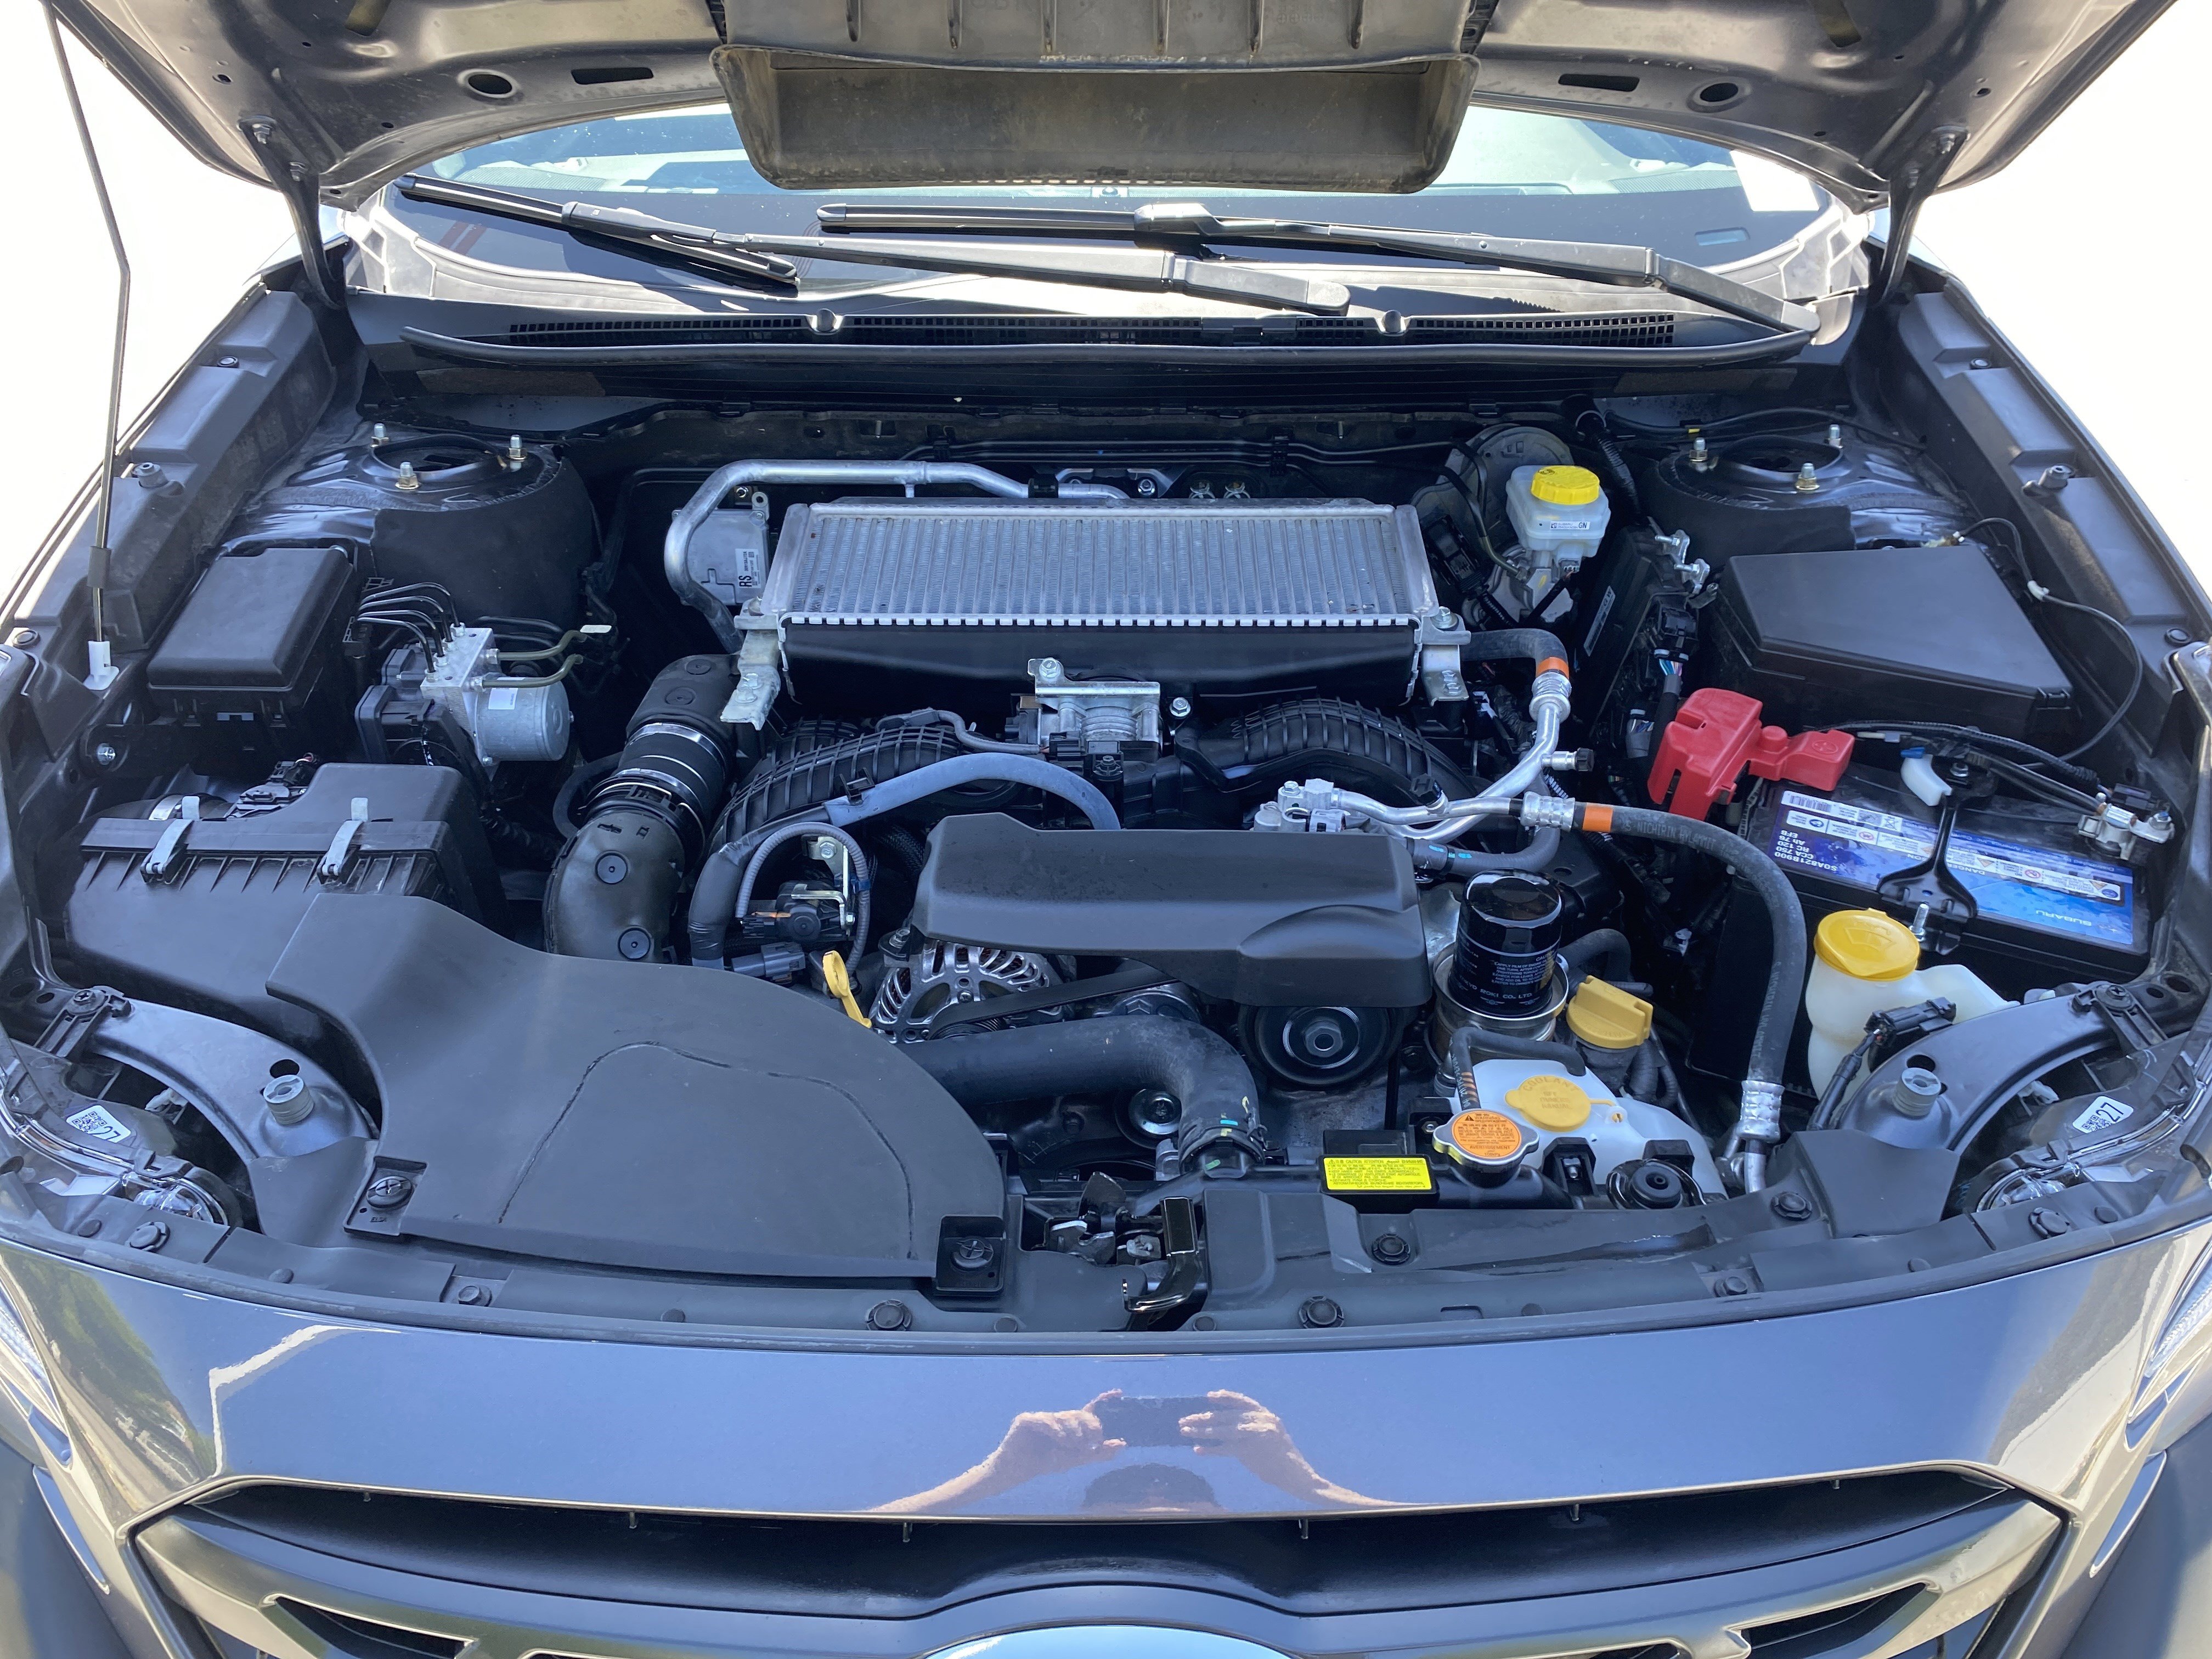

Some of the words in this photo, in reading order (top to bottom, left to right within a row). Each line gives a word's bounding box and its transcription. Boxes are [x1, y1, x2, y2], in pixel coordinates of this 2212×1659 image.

[738, 575, 752, 587] RS
[1781, 830, 1798, 838] EFB
[1778, 840, 1794, 849] 120
[1776, 845, 1793, 855] 750
[1795, 850, 1814, 859] CCA
[2036, 910, 2092, 927] SUBARU
[1480, 989, 1499, 997] ROKI
[1523, 1076, 1580, 1091] COOLANT
[2096, 1102, 2124, 1122] 27
